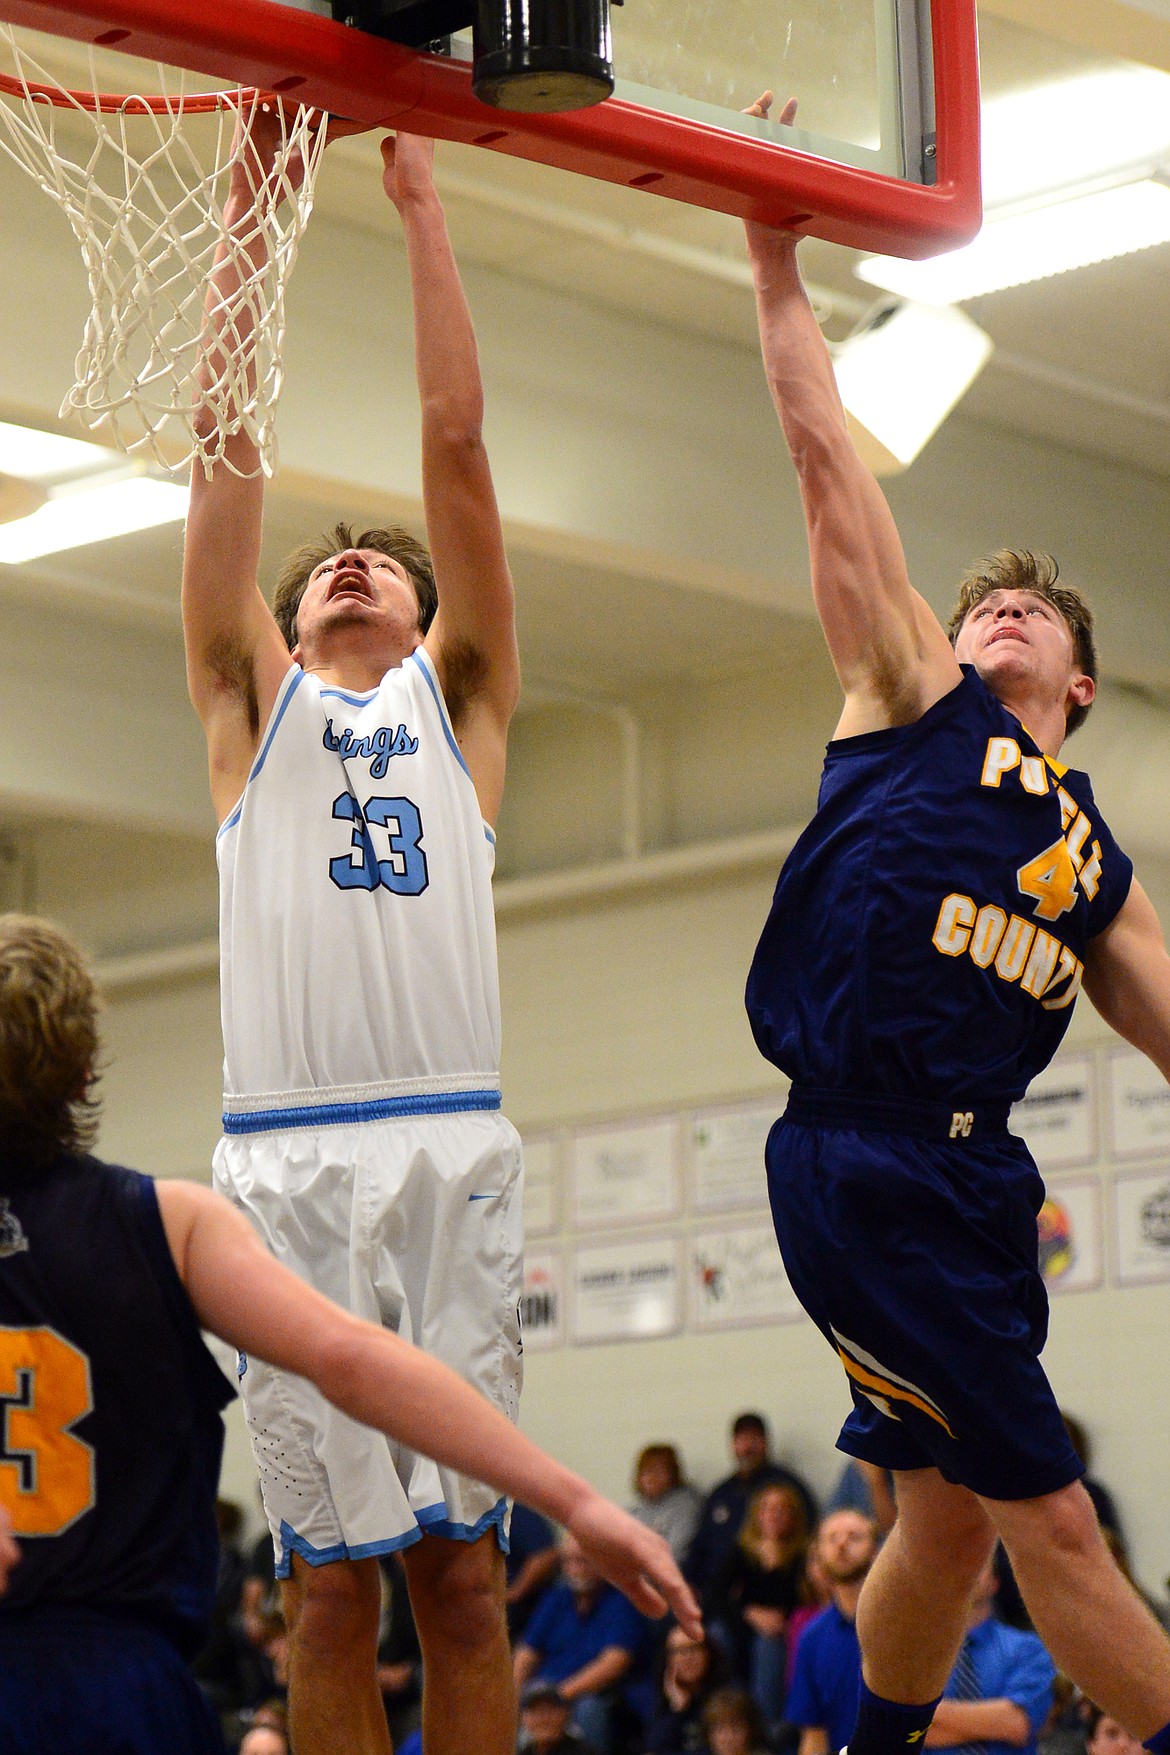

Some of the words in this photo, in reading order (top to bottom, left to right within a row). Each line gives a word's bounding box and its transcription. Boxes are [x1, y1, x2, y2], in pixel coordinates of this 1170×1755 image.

[328, 790, 430, 896] 33
[980, 737, 1103, 902] POELL
[1016, 834, 1079, 921] 4
[931, 893, 1085, 1011] COUNTY
[949, 1112, 975, 1138] PC
[0, 1324, 96, 1539] 3
